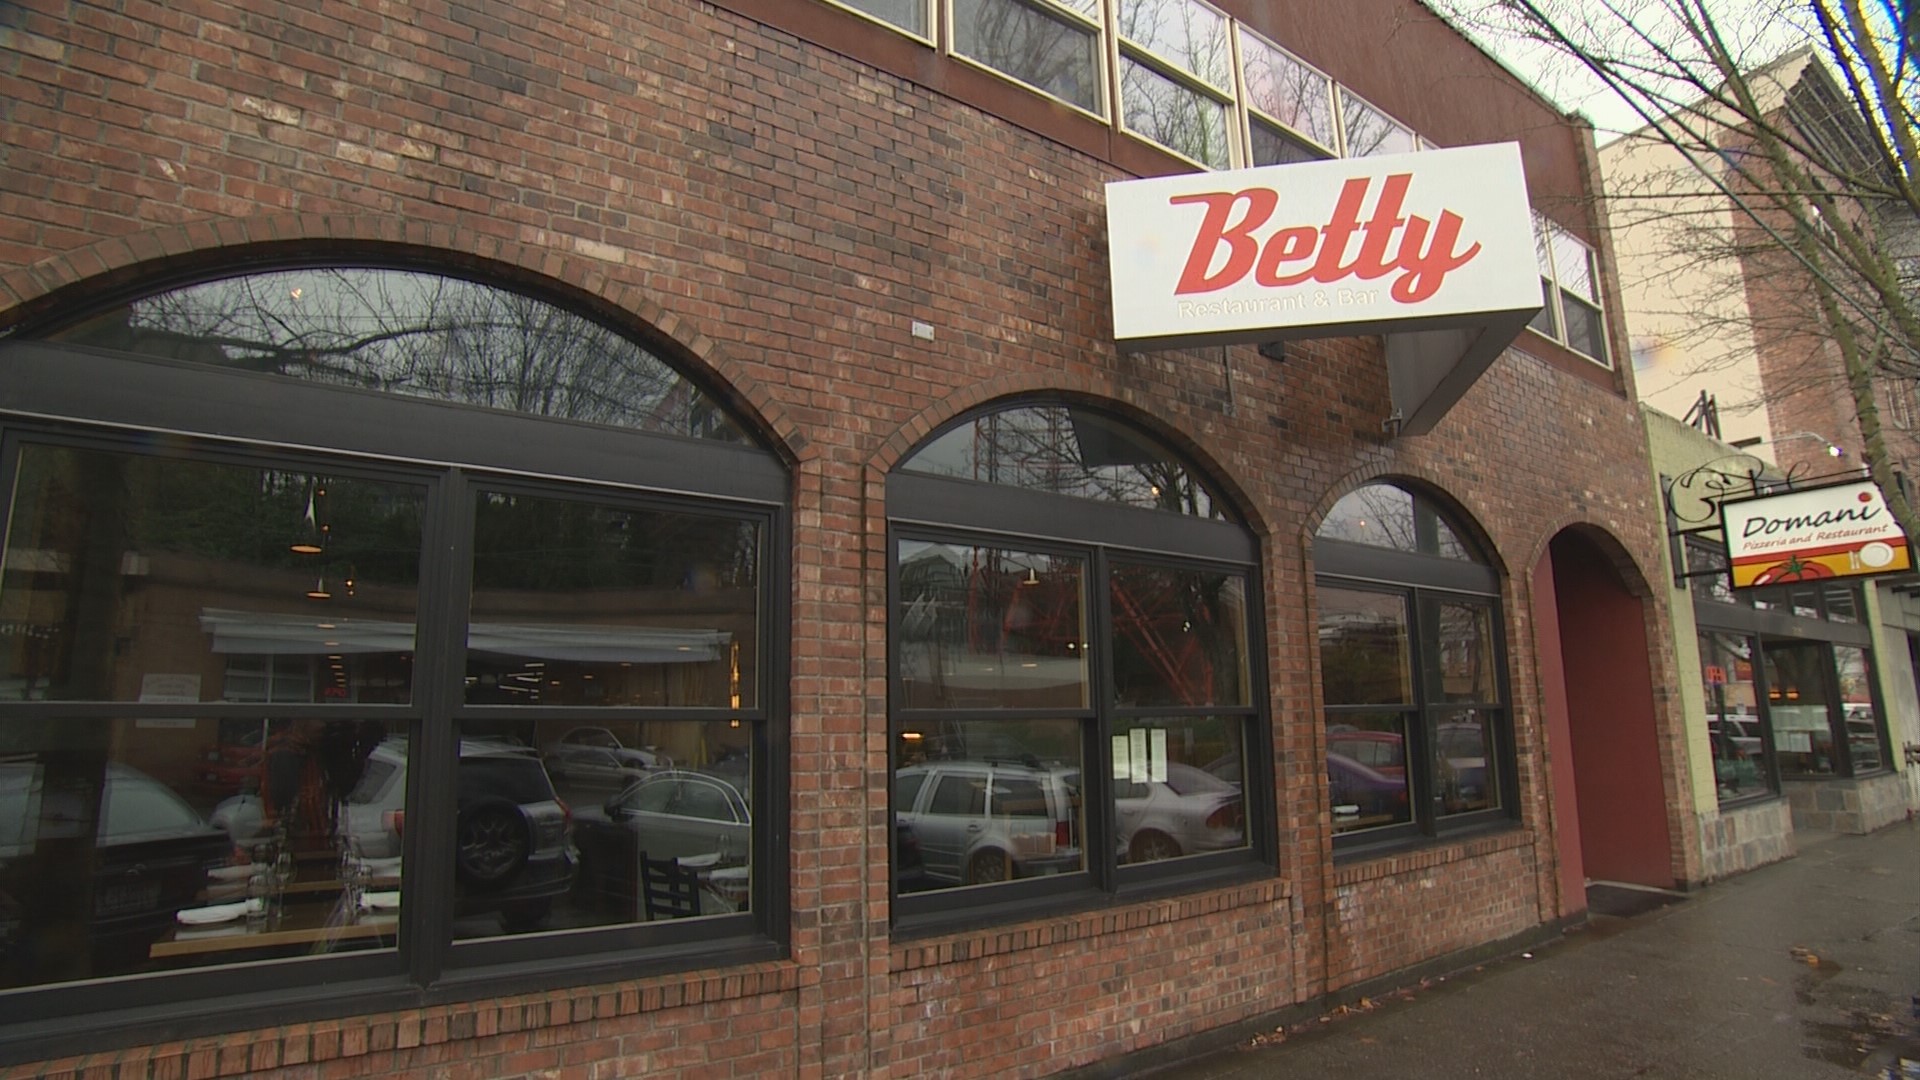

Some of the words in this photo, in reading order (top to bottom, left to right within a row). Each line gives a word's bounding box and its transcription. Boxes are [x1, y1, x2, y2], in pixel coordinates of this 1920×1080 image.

[1169, 173, 1482, 304] Betty
[1178, 293, 1306, 318] Restaurant
[1313, 289, 1331, 307] &
[1337, 287, 1379, 306] Bar
[1743, 492, 1881, 538] Domani
[1743, 536, 1787, 550] Pizzeria
[1788, 532, 1812, 544] and
[1816, 524, 1889, 541] Restaurant
